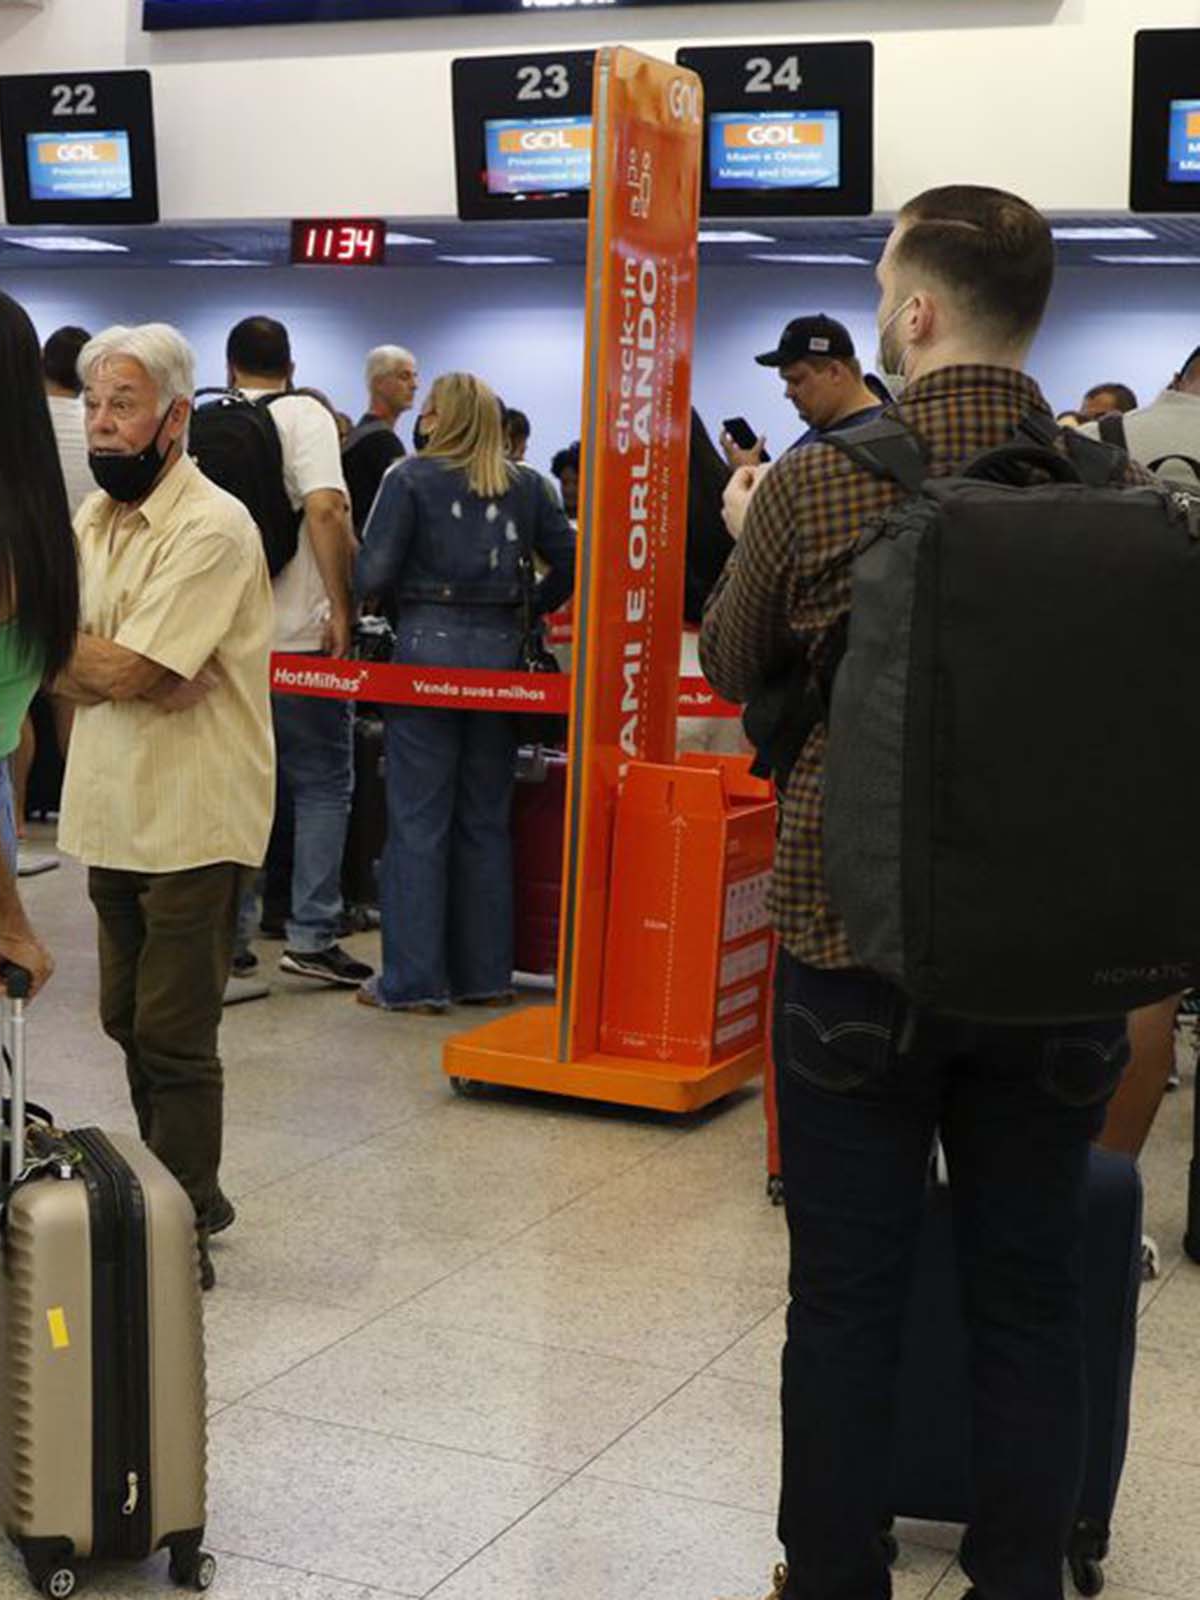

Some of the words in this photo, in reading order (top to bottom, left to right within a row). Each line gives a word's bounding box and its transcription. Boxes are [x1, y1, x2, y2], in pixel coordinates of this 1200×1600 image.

[516, 64, 569, 100] 23
[744, 56, 803, 93] 24
[51, 83, 97, 115] 22
[669, 79, 700, 124] GOL
[56, 143, 101, 161] GOL
[520, 130, 572, 150] GOL
[746, 125, 801, 145] GOL
[616, 256, 637, 455] check-in
[628, 258, 657, 571] ORLANDO
[626, 587, 646, 622] E
[273, 667, 361, 693] HotMilhas
[412, 680, 459, 697] Venda
[461, 685, 495, 698] suas
[497, 685, 546, 700] milhas
[618, 641, 643, 797] AMI
